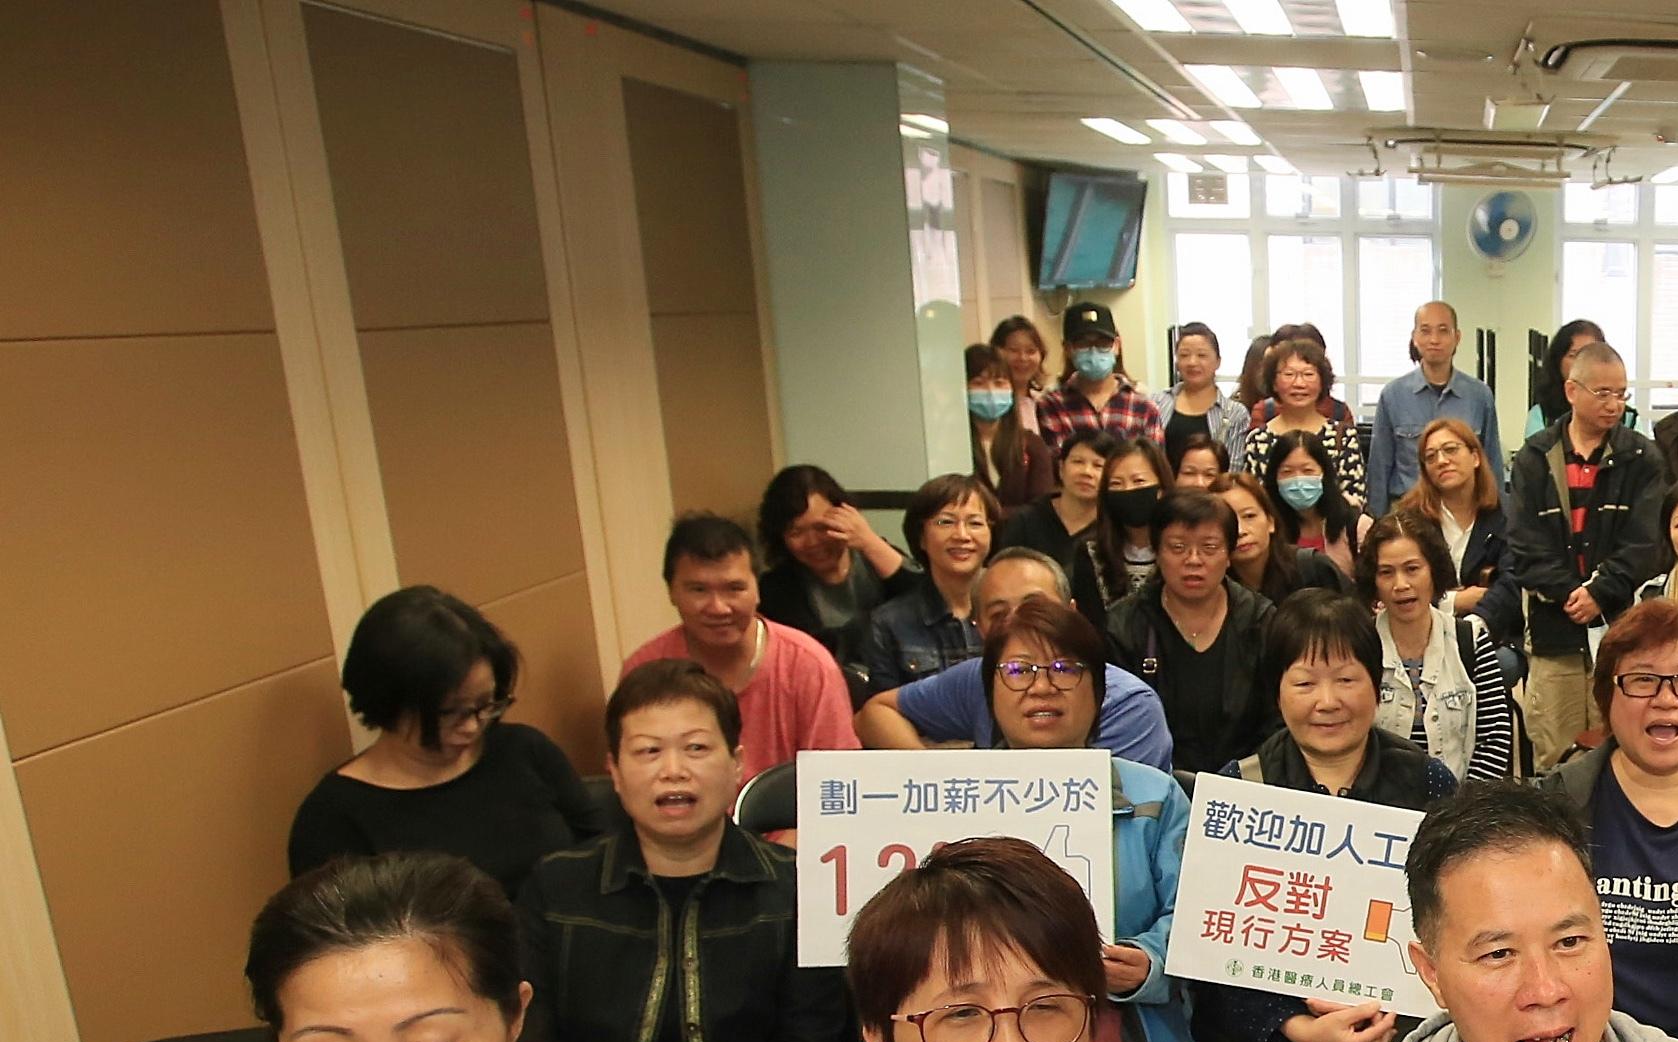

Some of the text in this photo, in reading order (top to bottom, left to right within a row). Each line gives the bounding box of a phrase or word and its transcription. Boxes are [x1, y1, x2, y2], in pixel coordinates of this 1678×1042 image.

[820, 777, 1099, 816] 劃一加薪不少於
[1203, 800, 1408, 870] 歡迎加人工
[1234, 865, 1333, 920] 反對
[1200, 910, 1353, 964] 現行方案
[1252, 965, 1394, 1002] 香港醫療人員總工會
